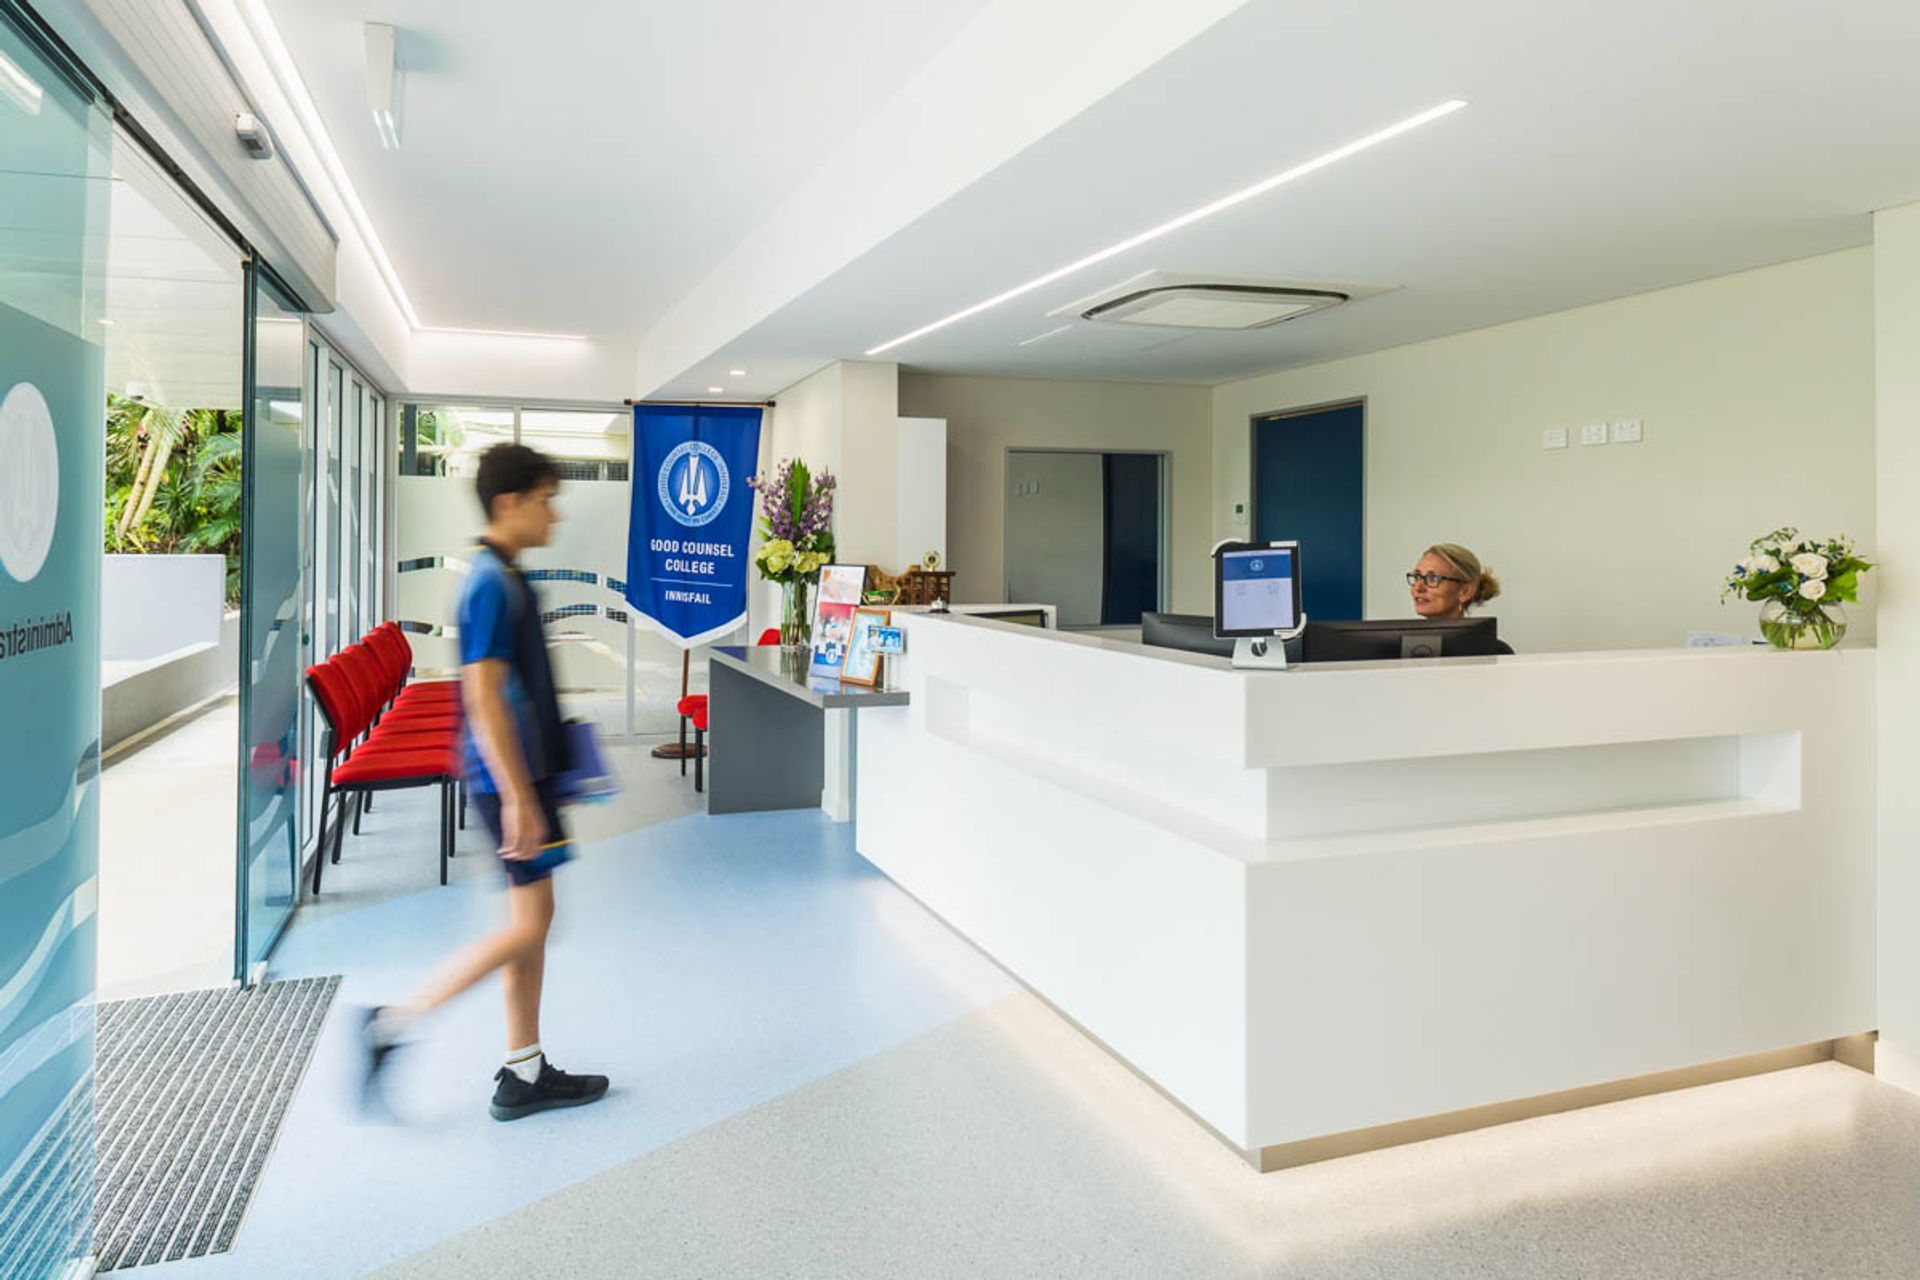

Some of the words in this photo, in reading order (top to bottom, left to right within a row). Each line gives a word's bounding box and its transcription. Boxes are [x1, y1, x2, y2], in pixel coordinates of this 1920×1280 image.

[650, 539, 680, 552] GOOD
[682, 541, 735, 557] COUNSEL
[665, 558, 715, 574] COLLEGE
